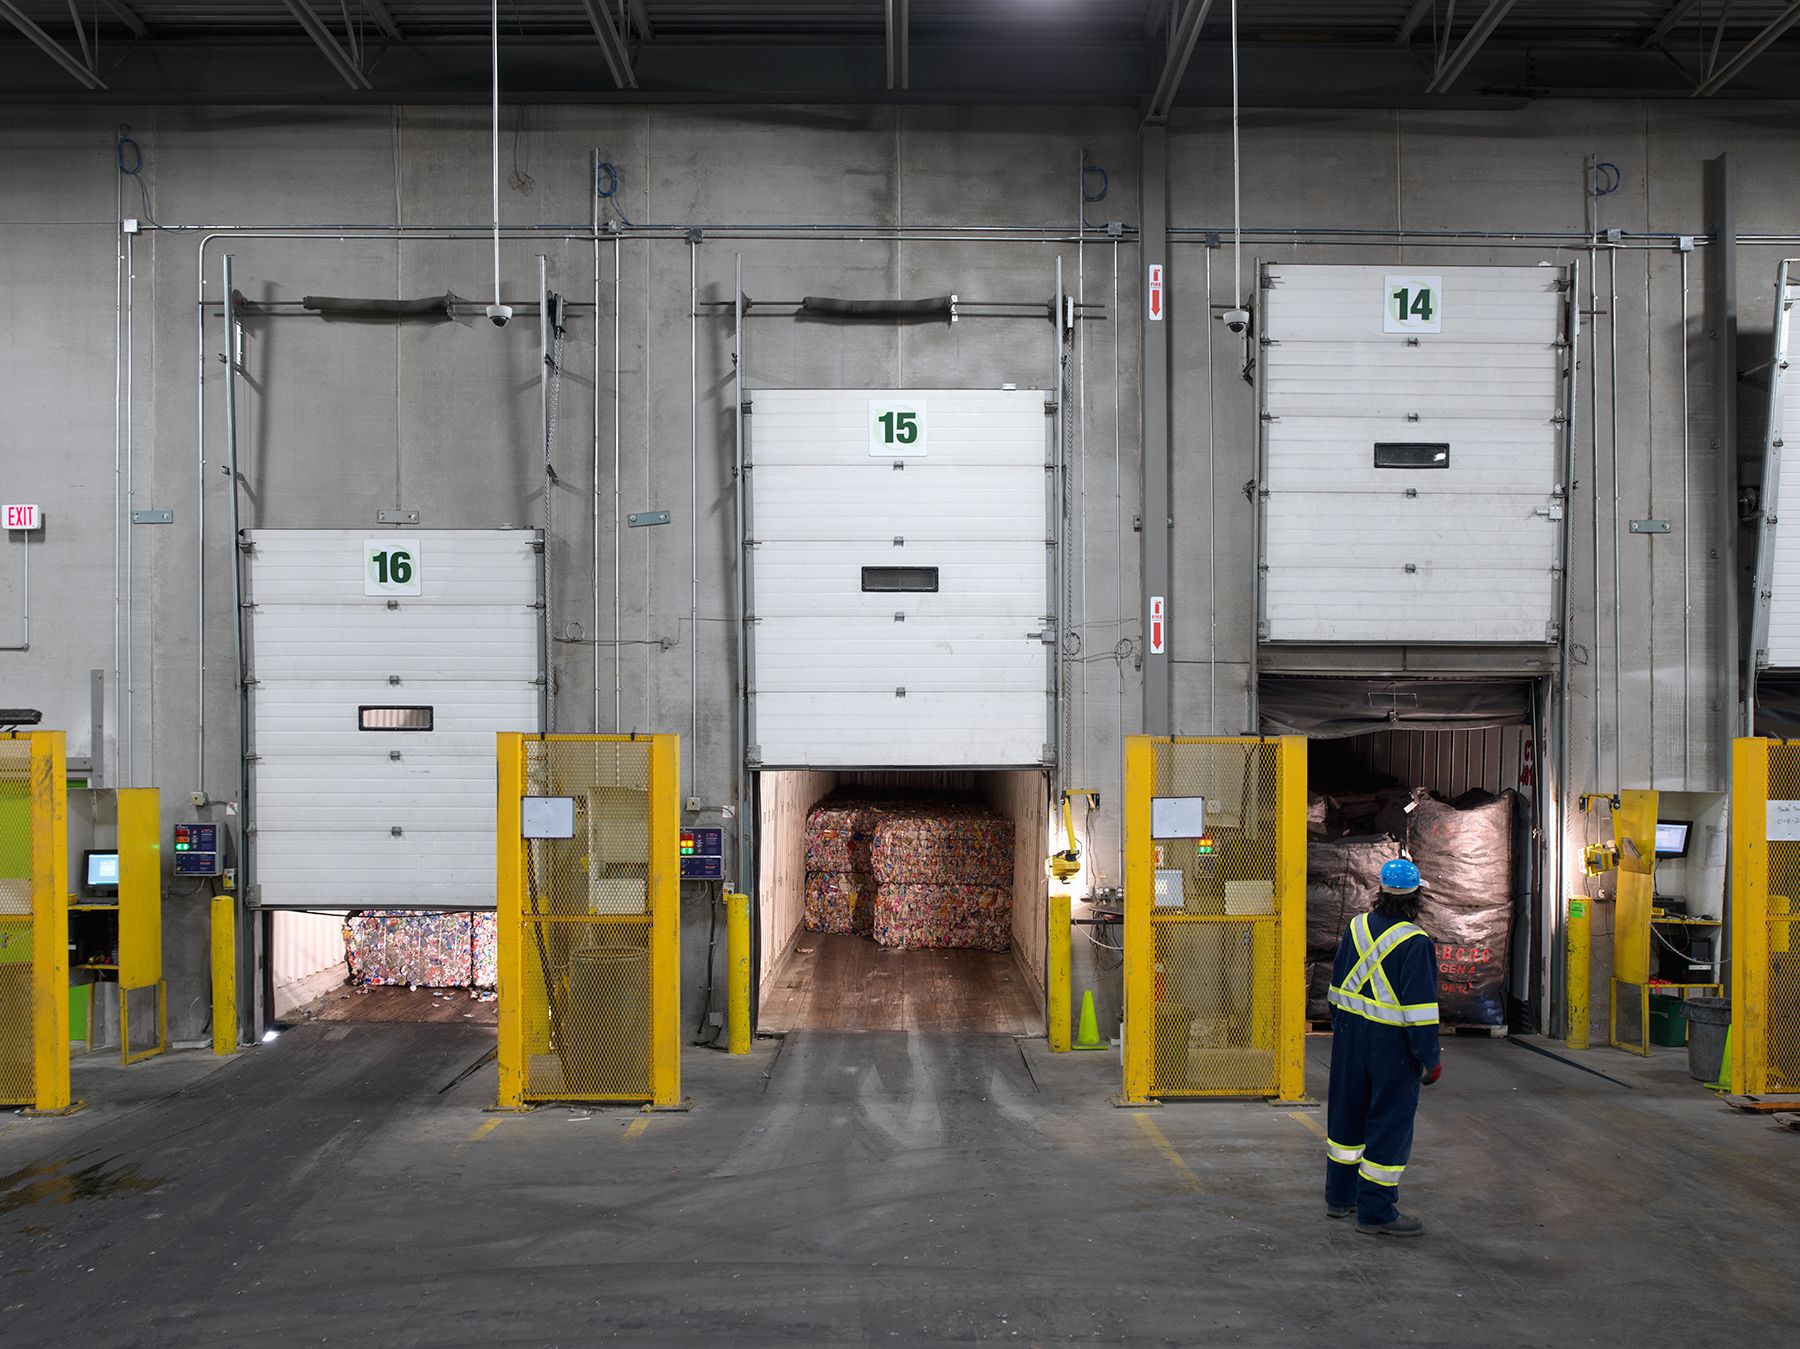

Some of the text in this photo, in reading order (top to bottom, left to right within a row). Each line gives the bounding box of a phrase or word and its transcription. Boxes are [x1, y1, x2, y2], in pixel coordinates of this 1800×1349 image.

[1393, 288, 1433, 321] 14
[878, 411, 918, 444] 15
[8, 506, 33, 526] EXIT
[372, 551, 412, 583] 16
[1439, 963, 1466, 974] GEN
